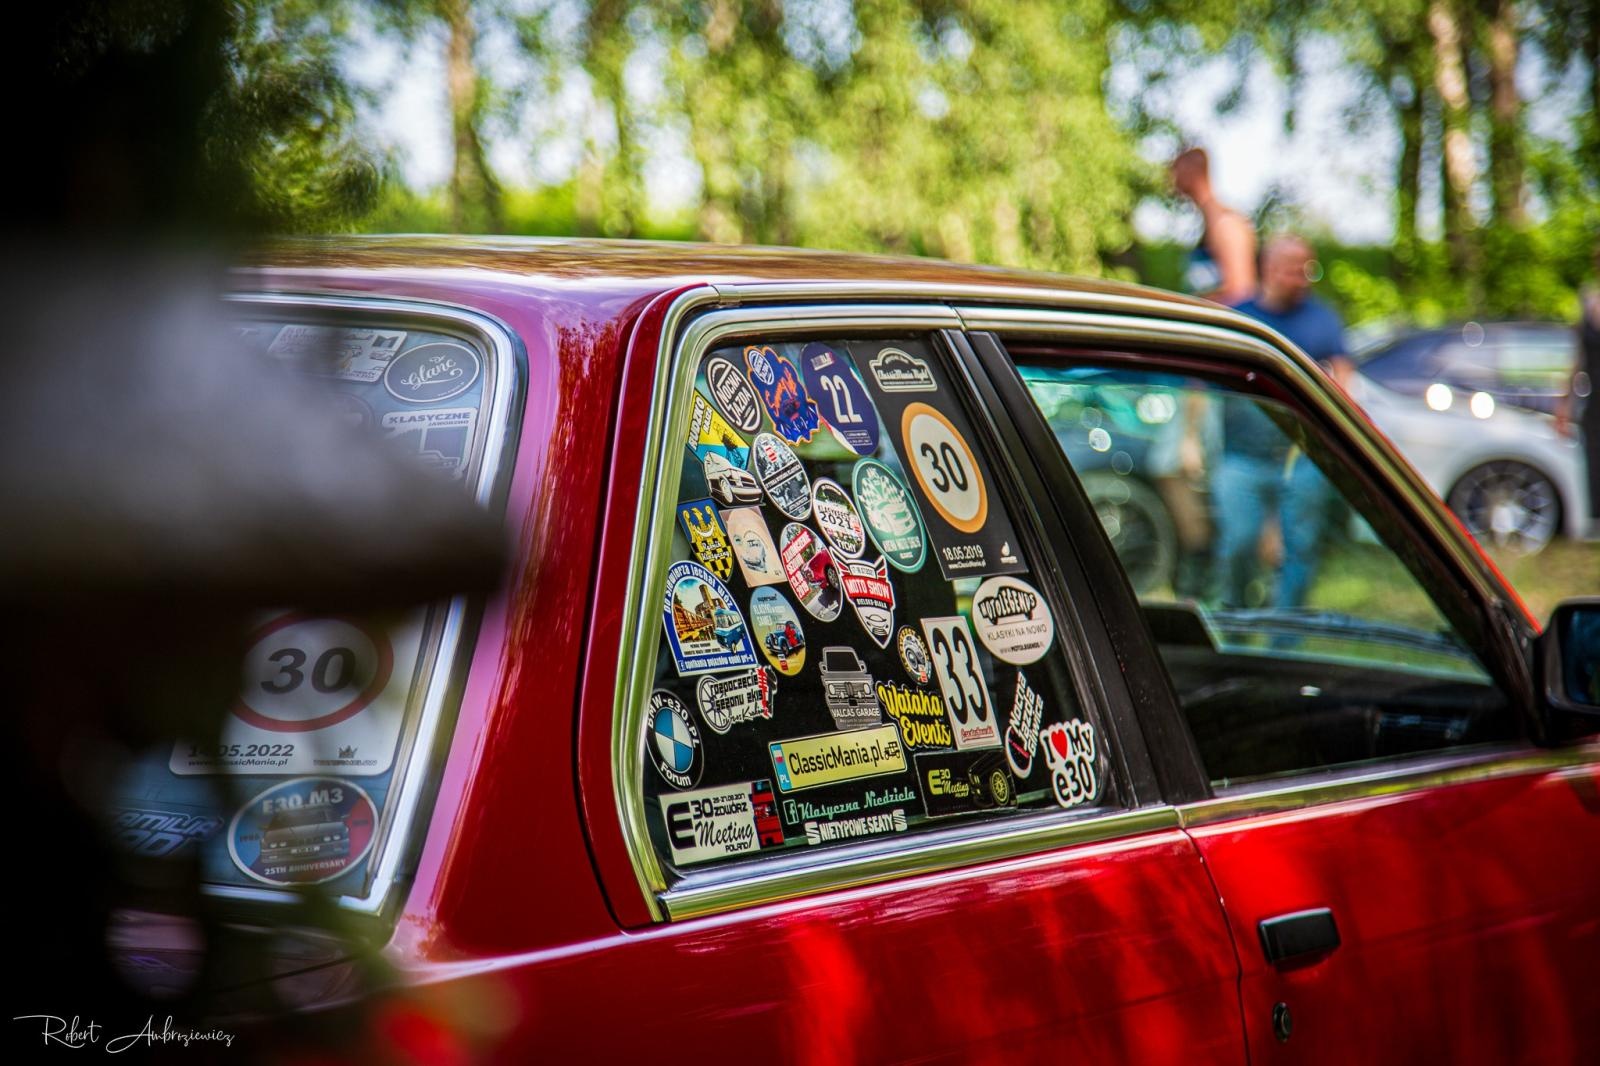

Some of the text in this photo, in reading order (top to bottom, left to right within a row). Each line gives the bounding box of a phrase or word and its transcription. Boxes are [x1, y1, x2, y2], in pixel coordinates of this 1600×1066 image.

[716, 370, 742, 404] NOCNA
[820, 375, 863, 423] 22
[389, 411, 471, 424] KLASYCZNE
[728, 386, 752, 427] JAZDA
[920, 441, 968, 493] 30
[820, 511, 853, 531] 2021
[942, 544, 984, 560] 18.05.2019
[845, 579, 890, 599] MOTO SHOW
[979, 587, 1036, 619] MOTOLEGENDS
[987, 624, 1047, 640] KLASYKI NA NOWO
[260, 647, 357, 695] 30
[932, 626, 988, 724] 33
[716, 694, 744, 710] sezonu
[831, 707, 881, 718] VALCAS GARAGE
[877, 685, 944, 716] Wataha
[1009, 671, 1027, 735] Nocna
[900, 716, 951, 747] Events
[1019, 686, 1035, 751] Jazda
[1027, 694, 1043, 758] Gliwice
[187, 744, 295, 757] 1405.2022
[788, 739, 884, 776] ClassicMania.pl
[1042, 721, 1092, 764] I My
[661, 762, 692, 787] Forum
[779, 774, 789, 783] PL
[941, 780, 970, 796] Meeting
[1057, 757, 1093, 802] e30
[798, 801, 860, 820] Klasyczna
[864, 786, 916, 808] Niedziela
[695, 820, 754, 848] Meeting
[819, 813, 894, 841] NIETYPOWE SEATY
[725, 842, 749, 853] POLAND
[264, 859, 346, 875] 25TH ANNIVERSARY
